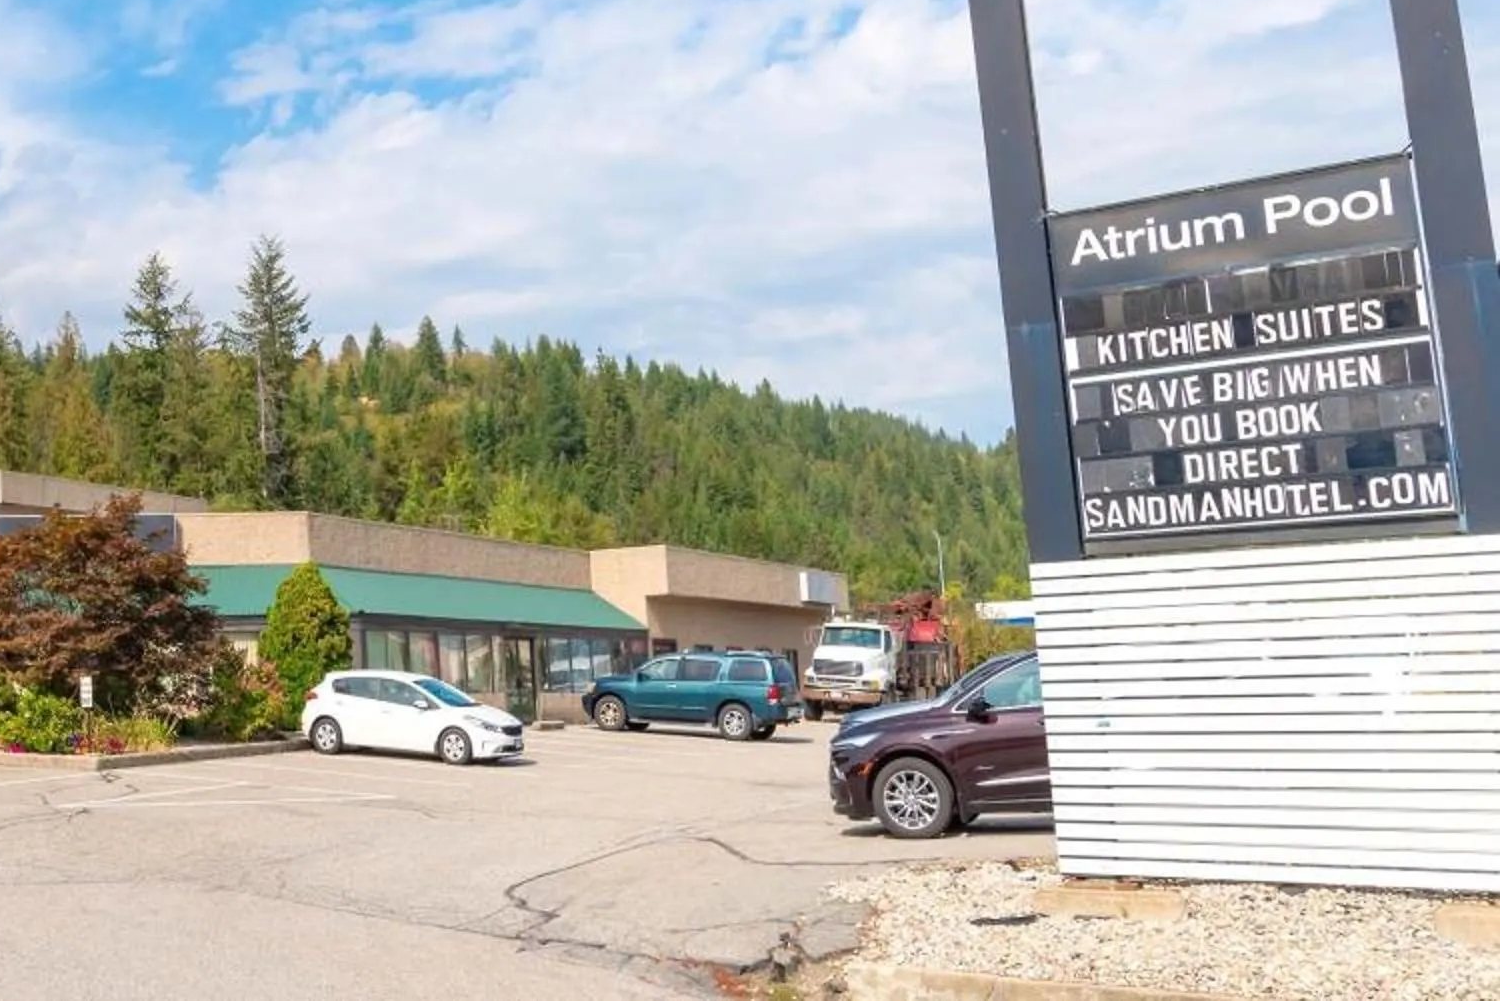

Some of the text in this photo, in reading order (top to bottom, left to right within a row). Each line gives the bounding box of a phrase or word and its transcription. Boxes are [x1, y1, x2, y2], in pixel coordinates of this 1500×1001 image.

[1070, 178, 1395, 265] Atrium Pool
[1097, 298, 1384, 365] KITCHEN SUITES
[1116, 354, 1382, 415] SAVE BIG WHEN
[1158, 400, 1323, 448] YOU BOOK
[1183, 443, 1304, 484] DIRECT
[1085, 471, 1450, 529] SANDMANHOTEL.COM
